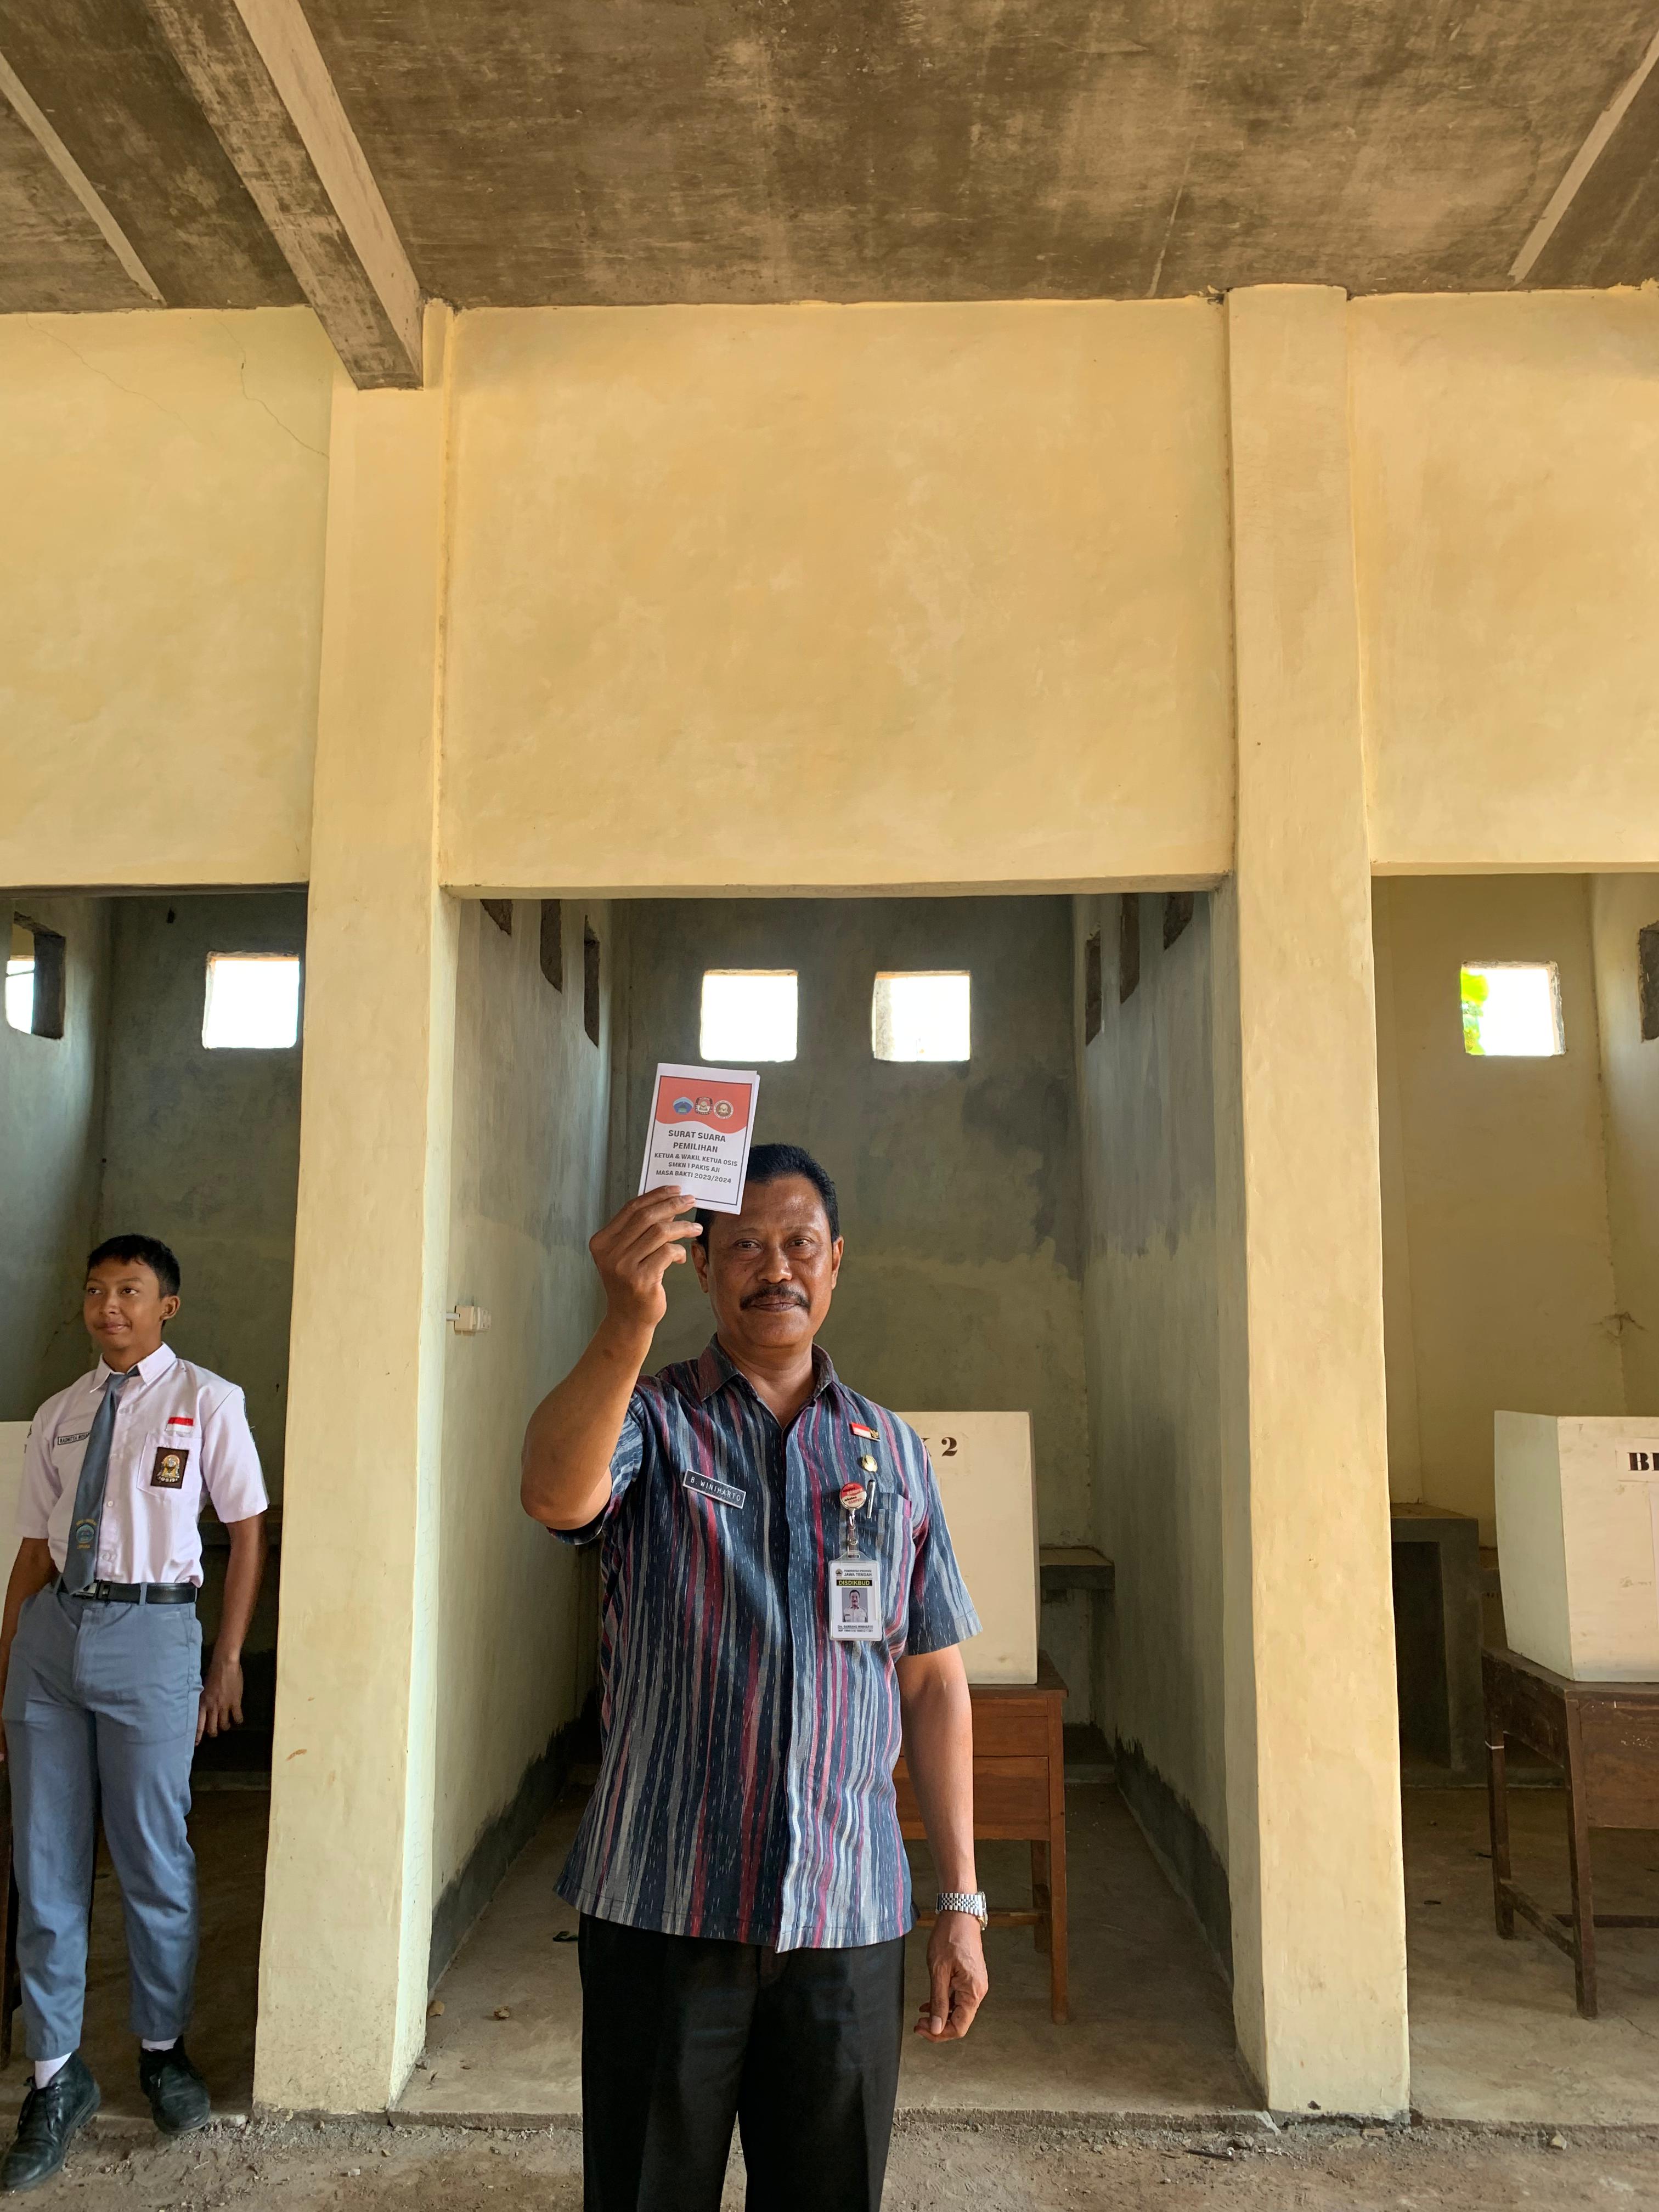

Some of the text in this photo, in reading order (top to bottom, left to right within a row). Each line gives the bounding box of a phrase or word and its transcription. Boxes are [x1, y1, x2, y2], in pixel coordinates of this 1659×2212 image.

[668, 1130, 726, 1142] SURAT SUARA
[673, 1142, 718, 1153] PEMILIHAN
[694, 1173, 731, 1183] 2023/2024
[941, 1437, 958, 1457] 2
[700, 1480, 741, 1502] WINIHARTO
